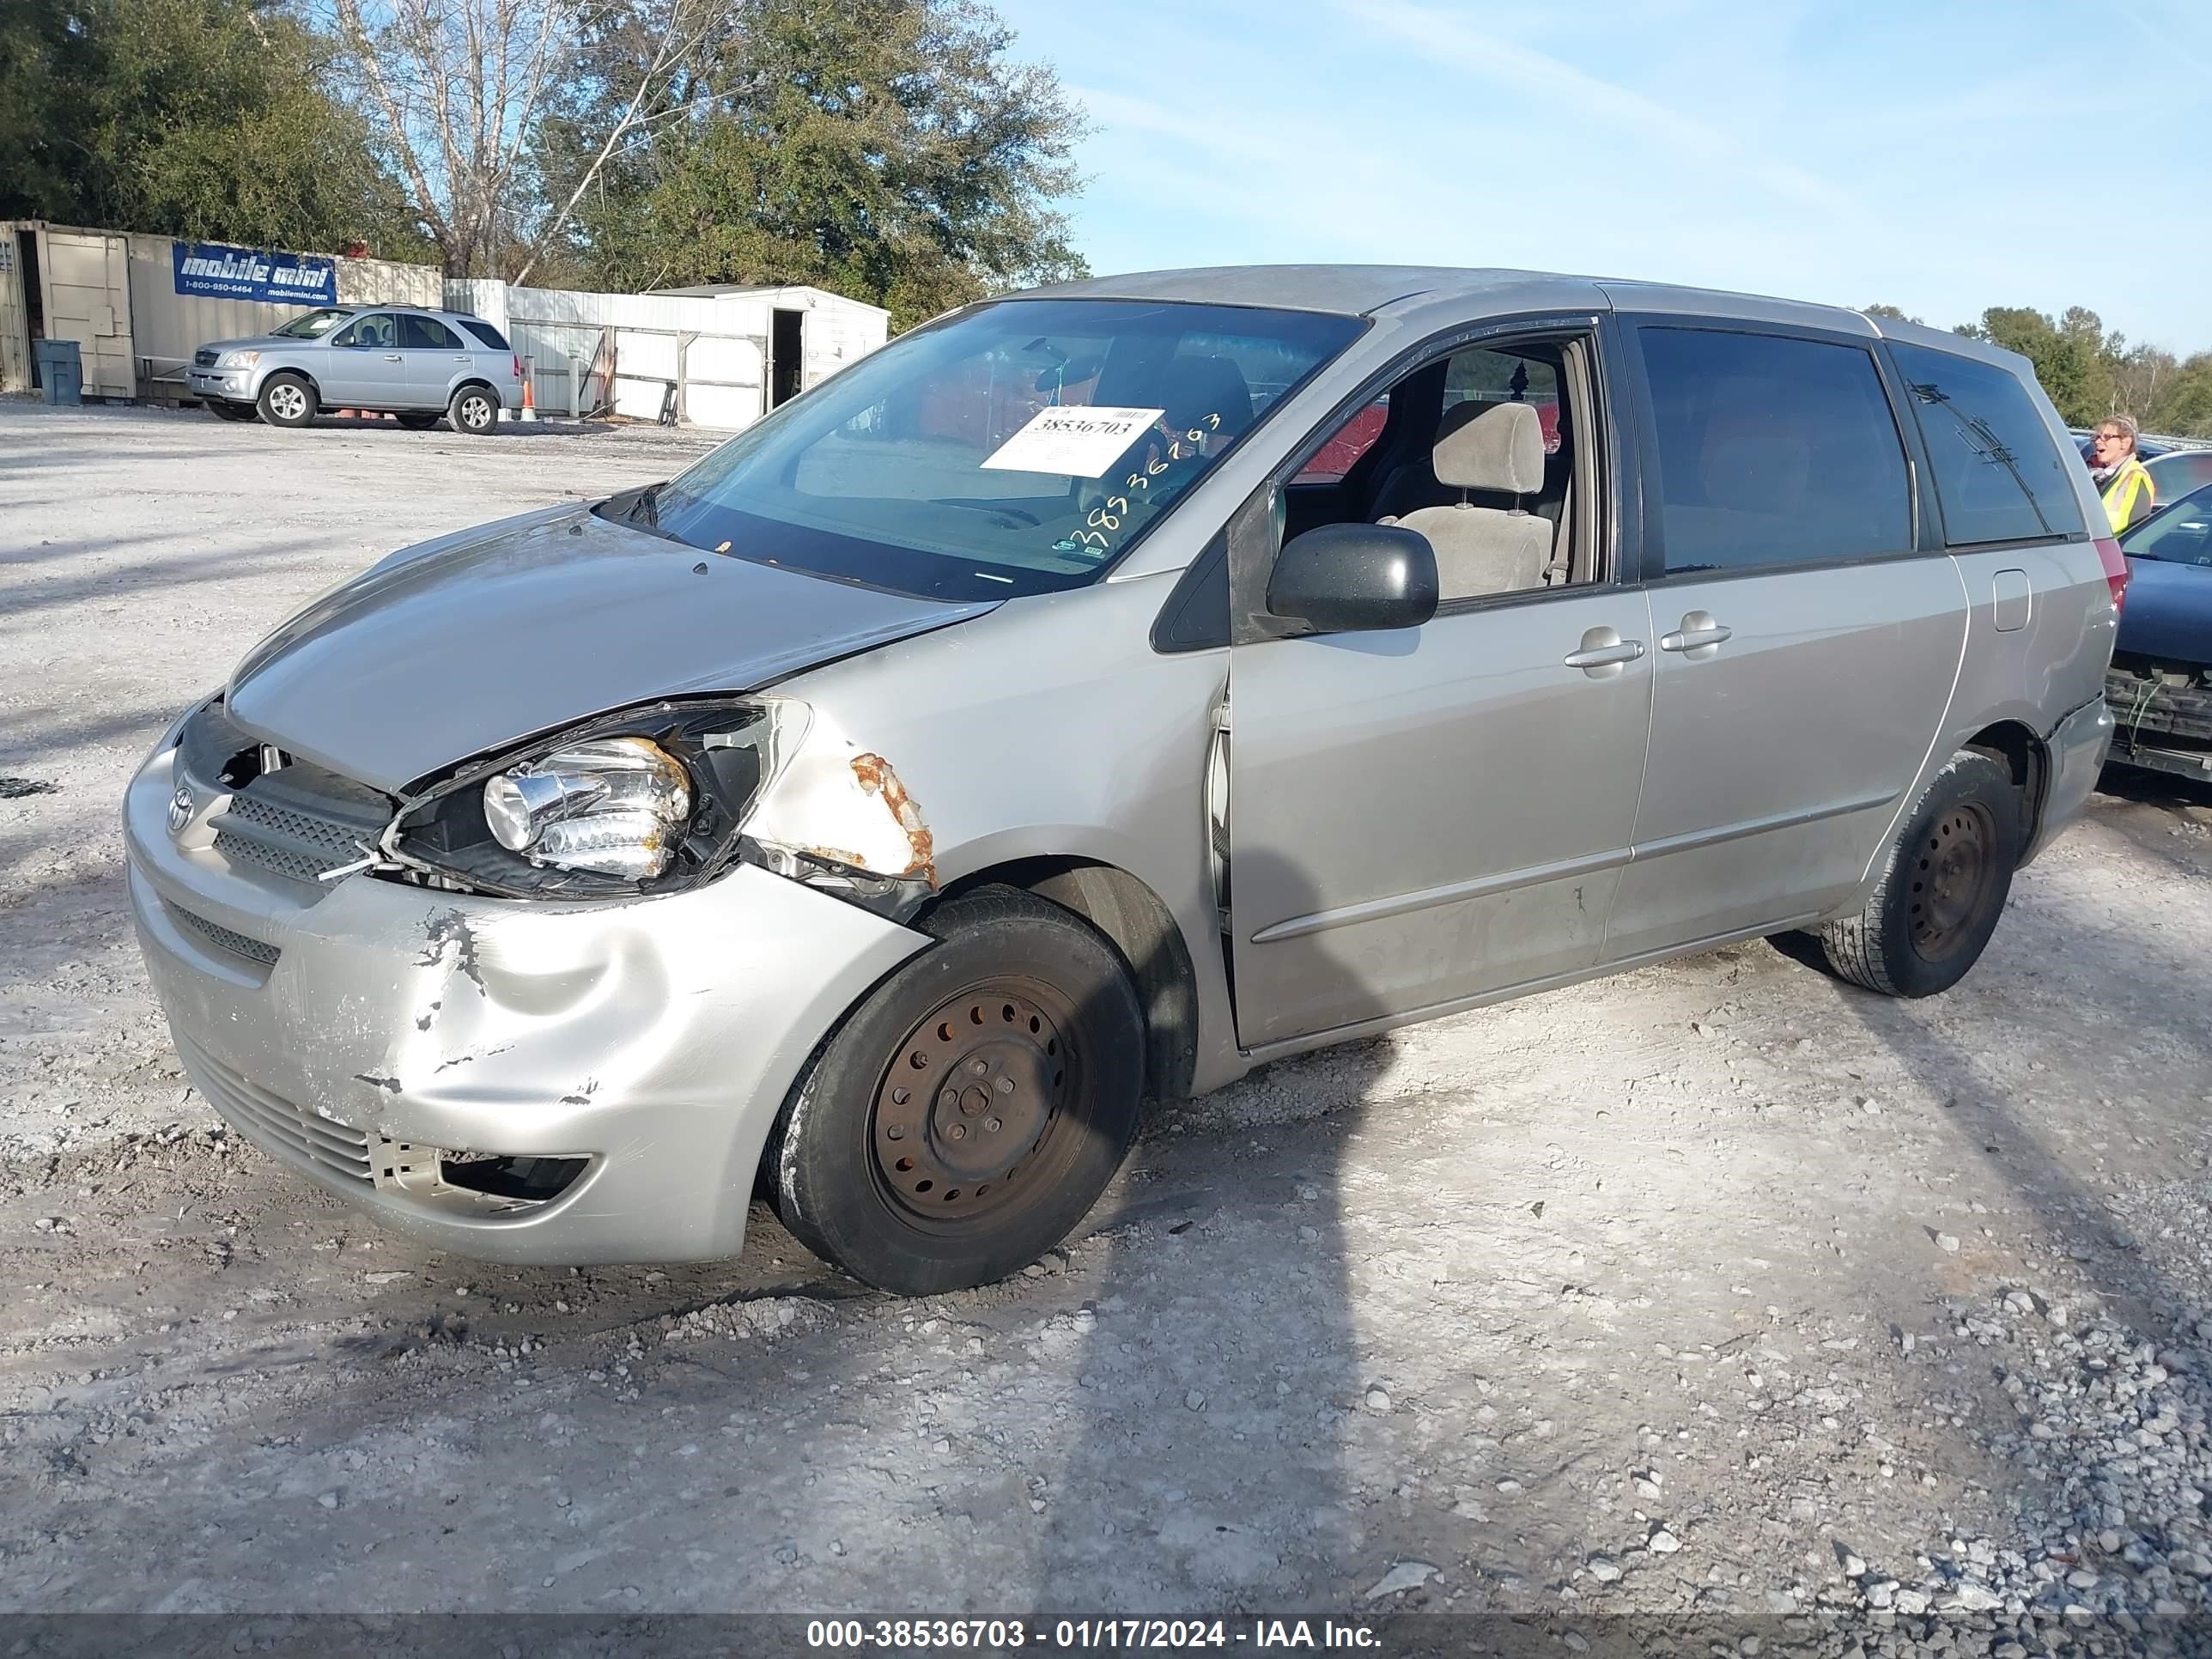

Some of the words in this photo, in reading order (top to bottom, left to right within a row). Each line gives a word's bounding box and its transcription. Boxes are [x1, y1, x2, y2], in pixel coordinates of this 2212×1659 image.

[180, 253, 270, 283] mobile
[272, 265, 329, 288] mini
[185, 280, 252, 294] 1-800-950-6464
[267, 289, 328, 301] mobilemini.com
[1035, 419, 1132, 435] 38536703
